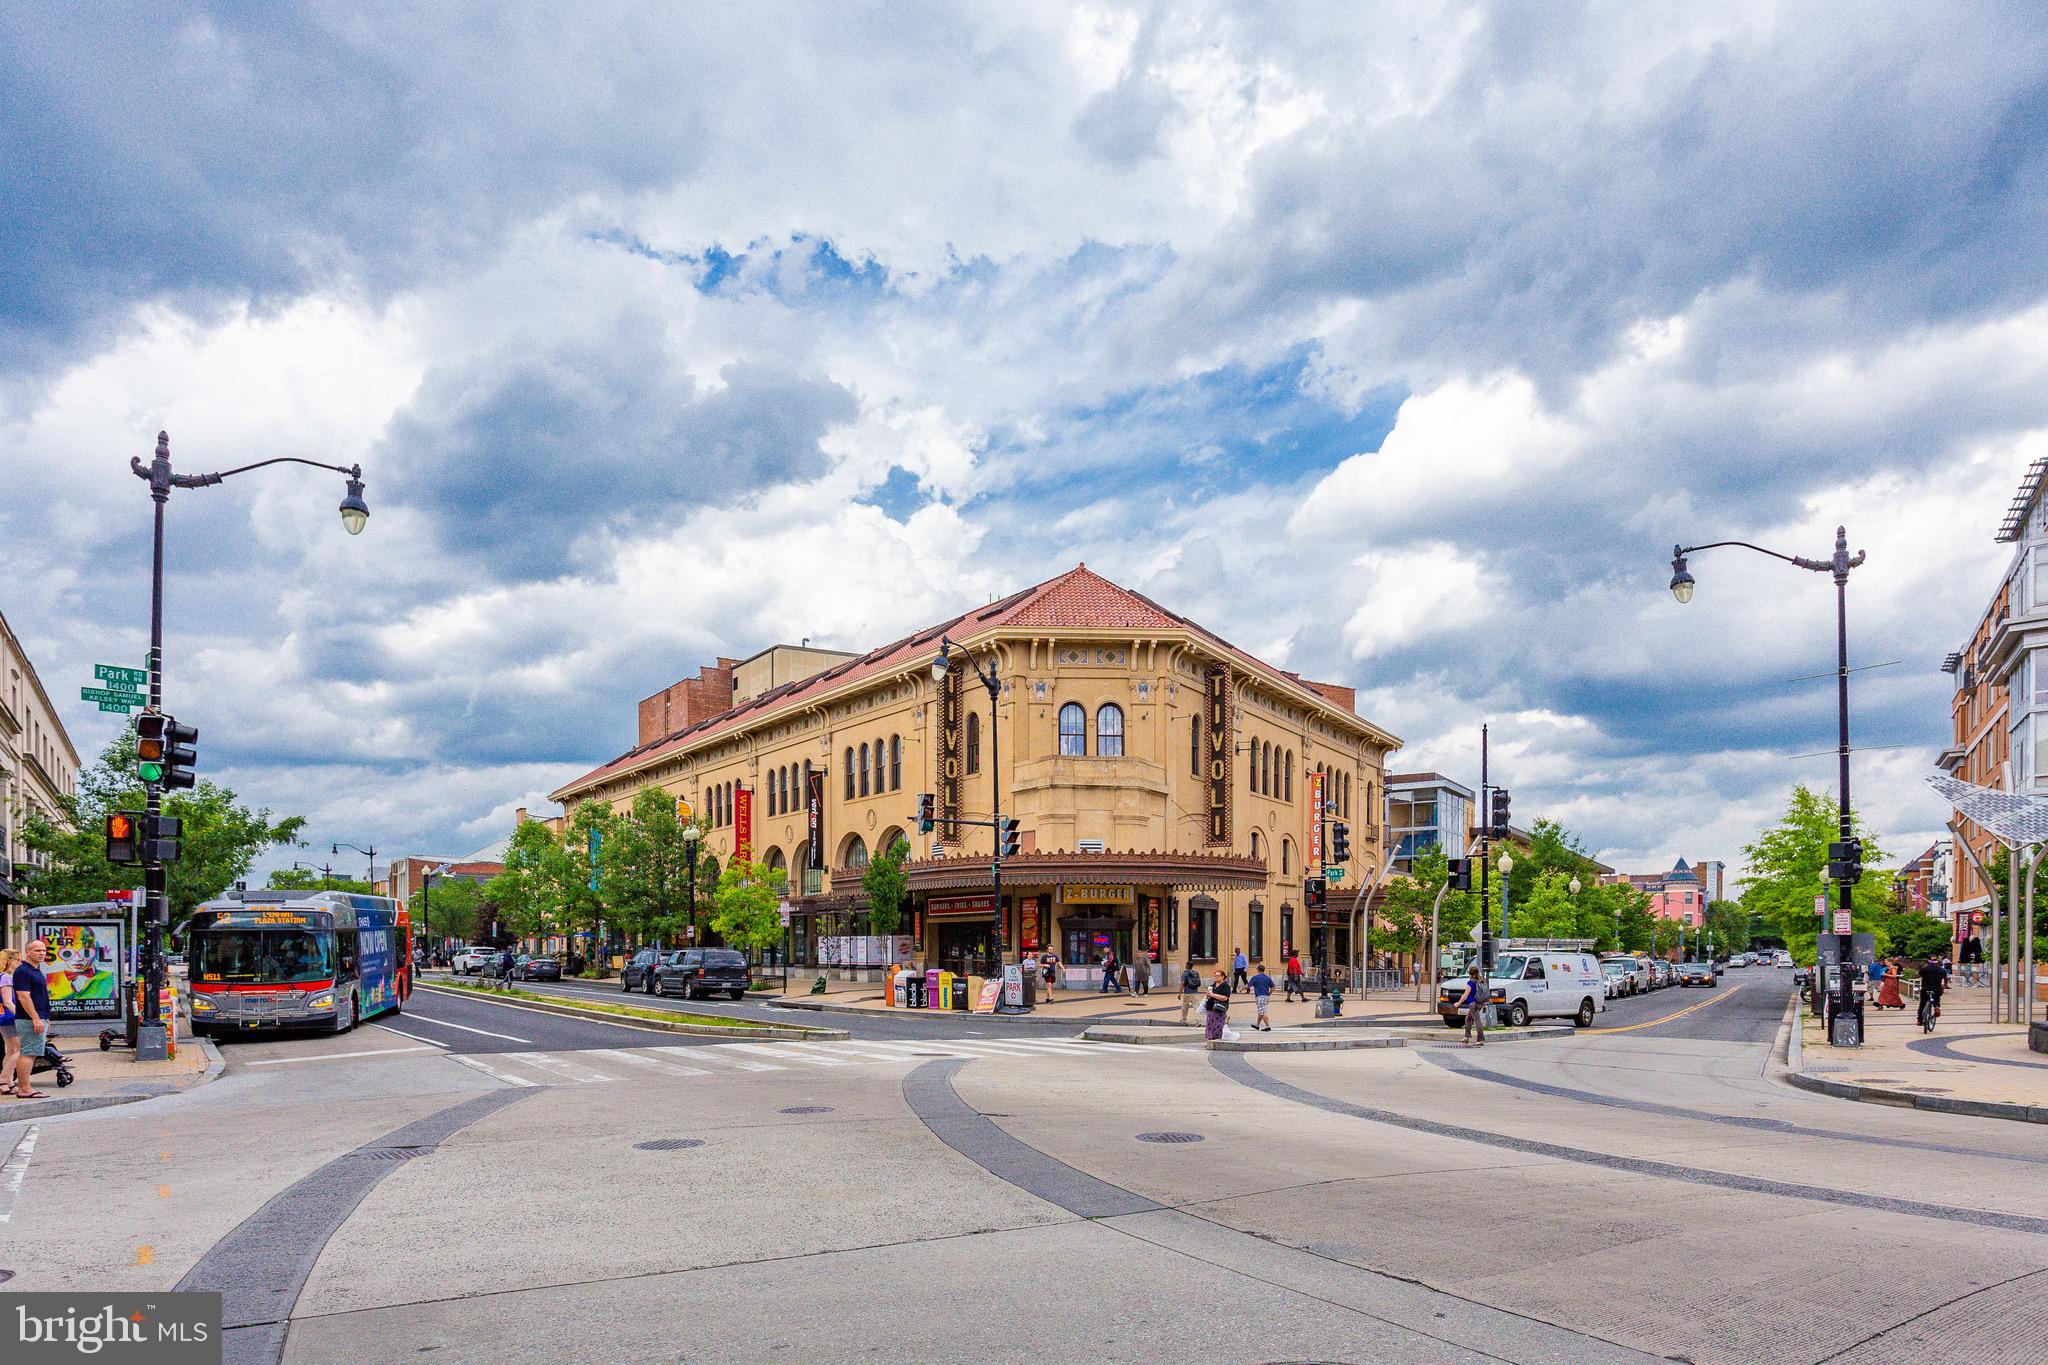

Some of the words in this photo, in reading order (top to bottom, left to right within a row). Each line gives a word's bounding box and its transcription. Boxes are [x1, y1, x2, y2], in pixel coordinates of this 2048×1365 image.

[99, 667, 128, 681] Park
[109, 681, 135, 692] 1400
[83, 689, 111, 697] BISHOP
[113, 692, 143, 700] SAMUEL
[102, 703, 128, 713] 1400
[944, 672, 958, 835] TIVOLI
[1211, 675, 1225, 836] TIVOLI
[1315, 778, 1321, 787] Z
[739, 794, 747, 834] WELLS
[810, 799, 818, 828] verizon
[1313, 790, 1321, 856] BURGER
[1067, 889, 1130, 900] Z-BURGER
[217, 912, 230, 924] 52
[43, 927, 68, 936] UNI
[360, 931, 374, 956] NOW
[375, 930, 387, 952] OPEN
[1006, 982, 1021, 991] PARK
[909, 983, 917, 1006] blade
